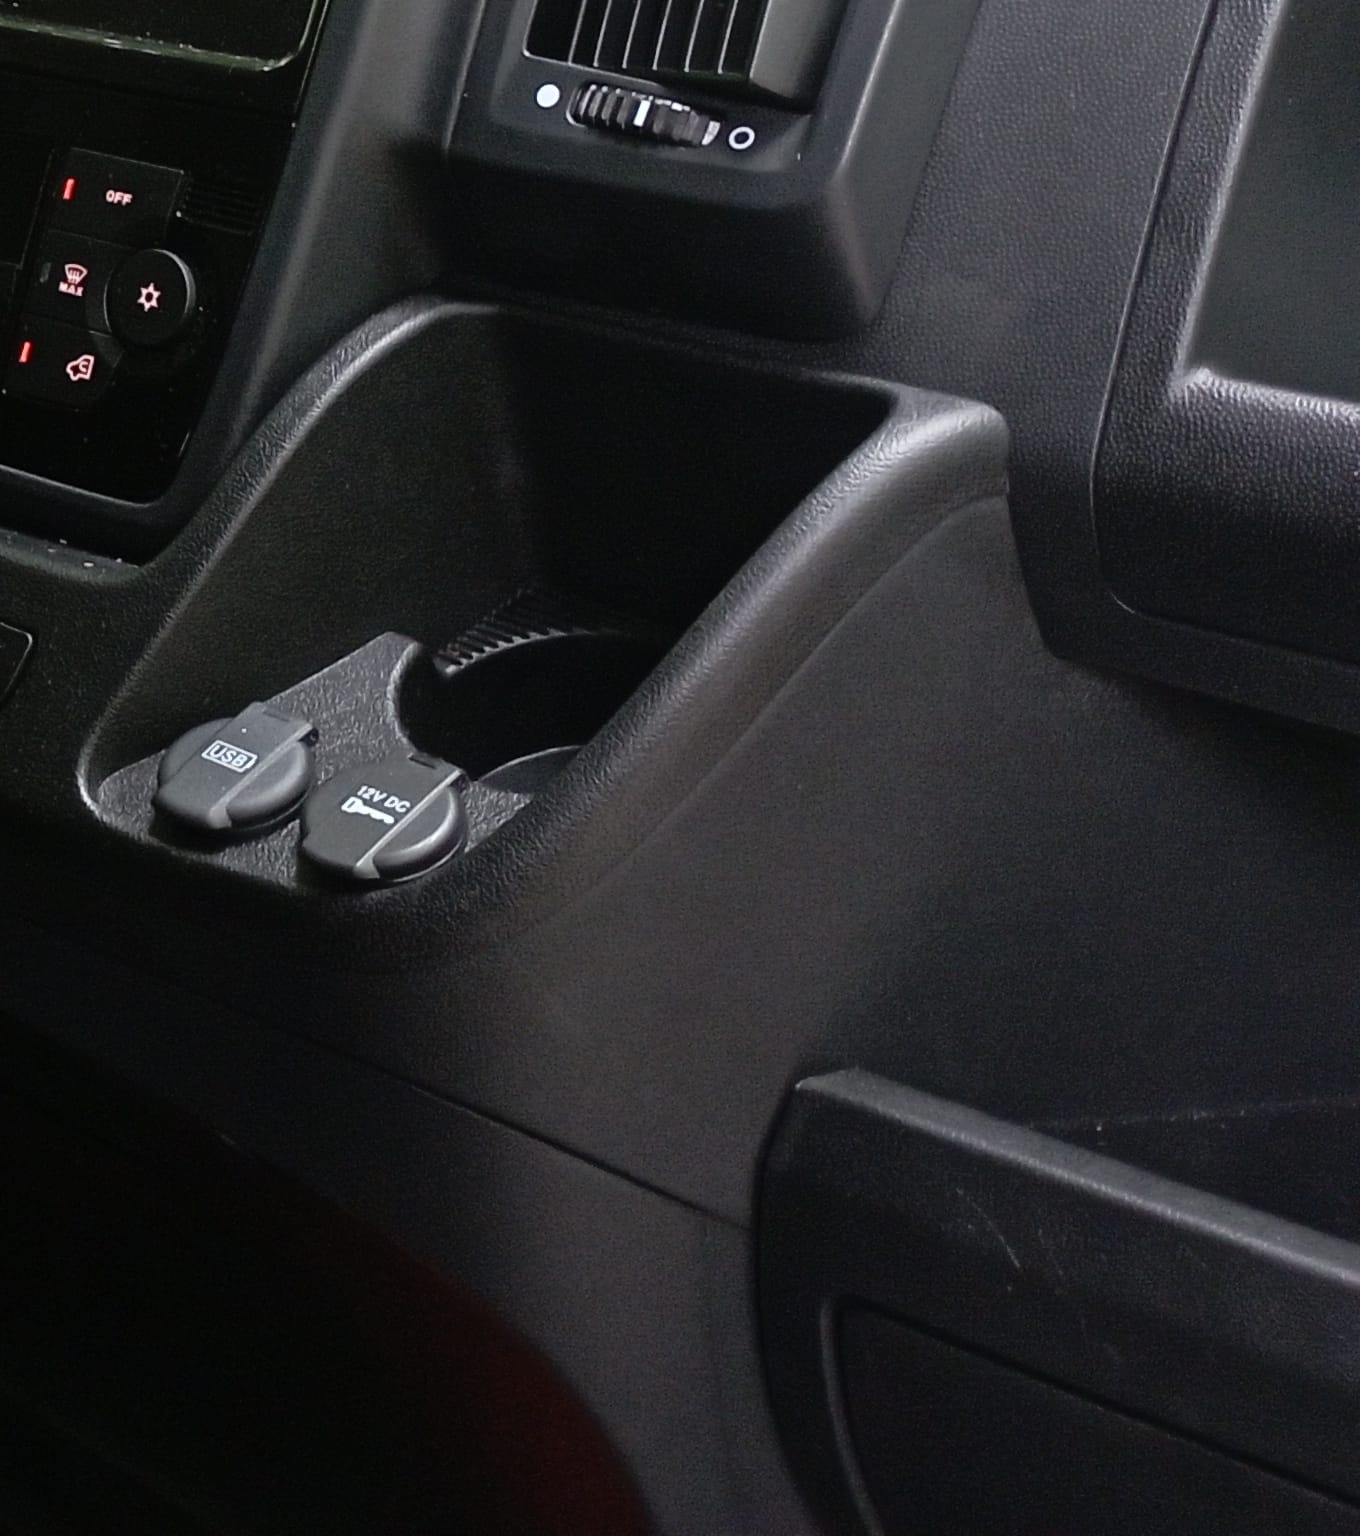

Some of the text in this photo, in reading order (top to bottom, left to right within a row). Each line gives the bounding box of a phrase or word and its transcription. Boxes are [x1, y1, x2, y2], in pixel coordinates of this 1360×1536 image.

[105, 189, 133, 206] OFF
[58, 281, 84, 297] MAX
[208, 744, 248, 767] USB
[357, 785, 411, 813] 12V DC
